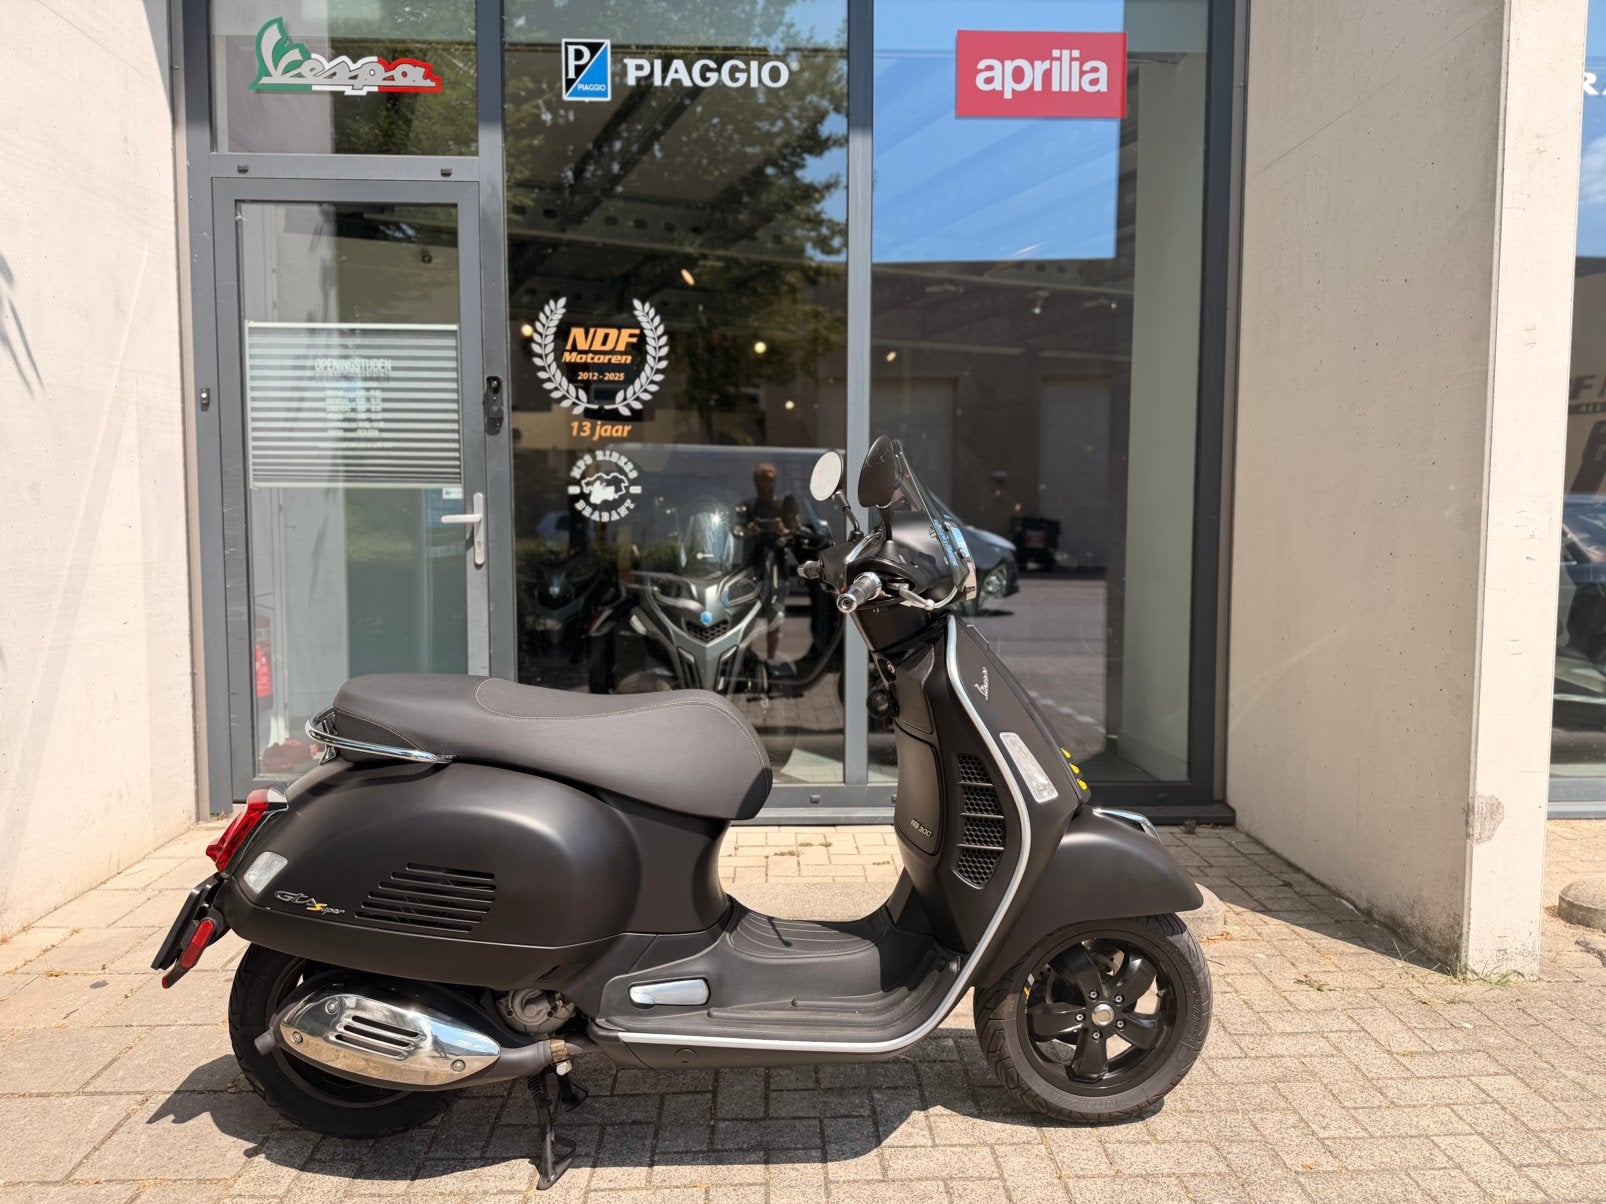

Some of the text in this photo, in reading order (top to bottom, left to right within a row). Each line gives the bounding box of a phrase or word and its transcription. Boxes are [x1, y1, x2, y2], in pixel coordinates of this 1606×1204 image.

[252, 20, 439, 93] Vespa
[623, 58, 790, 88] PIAGGIO
[975, 49, 1108, 99] aprilia
[577, 83, 607, 92] PIAGGIO
[565, 327, 641, 351] NDF
[561, 351, 632, 364] Motoren
[577, 372, 598, 380] 2012
[604, 372, 625, 381] 2025
[570, 420, 632, 441] 13 jaar
[595, 450, 638, 479] RIDERS
[574, 499, 635, 522] BRABANT
